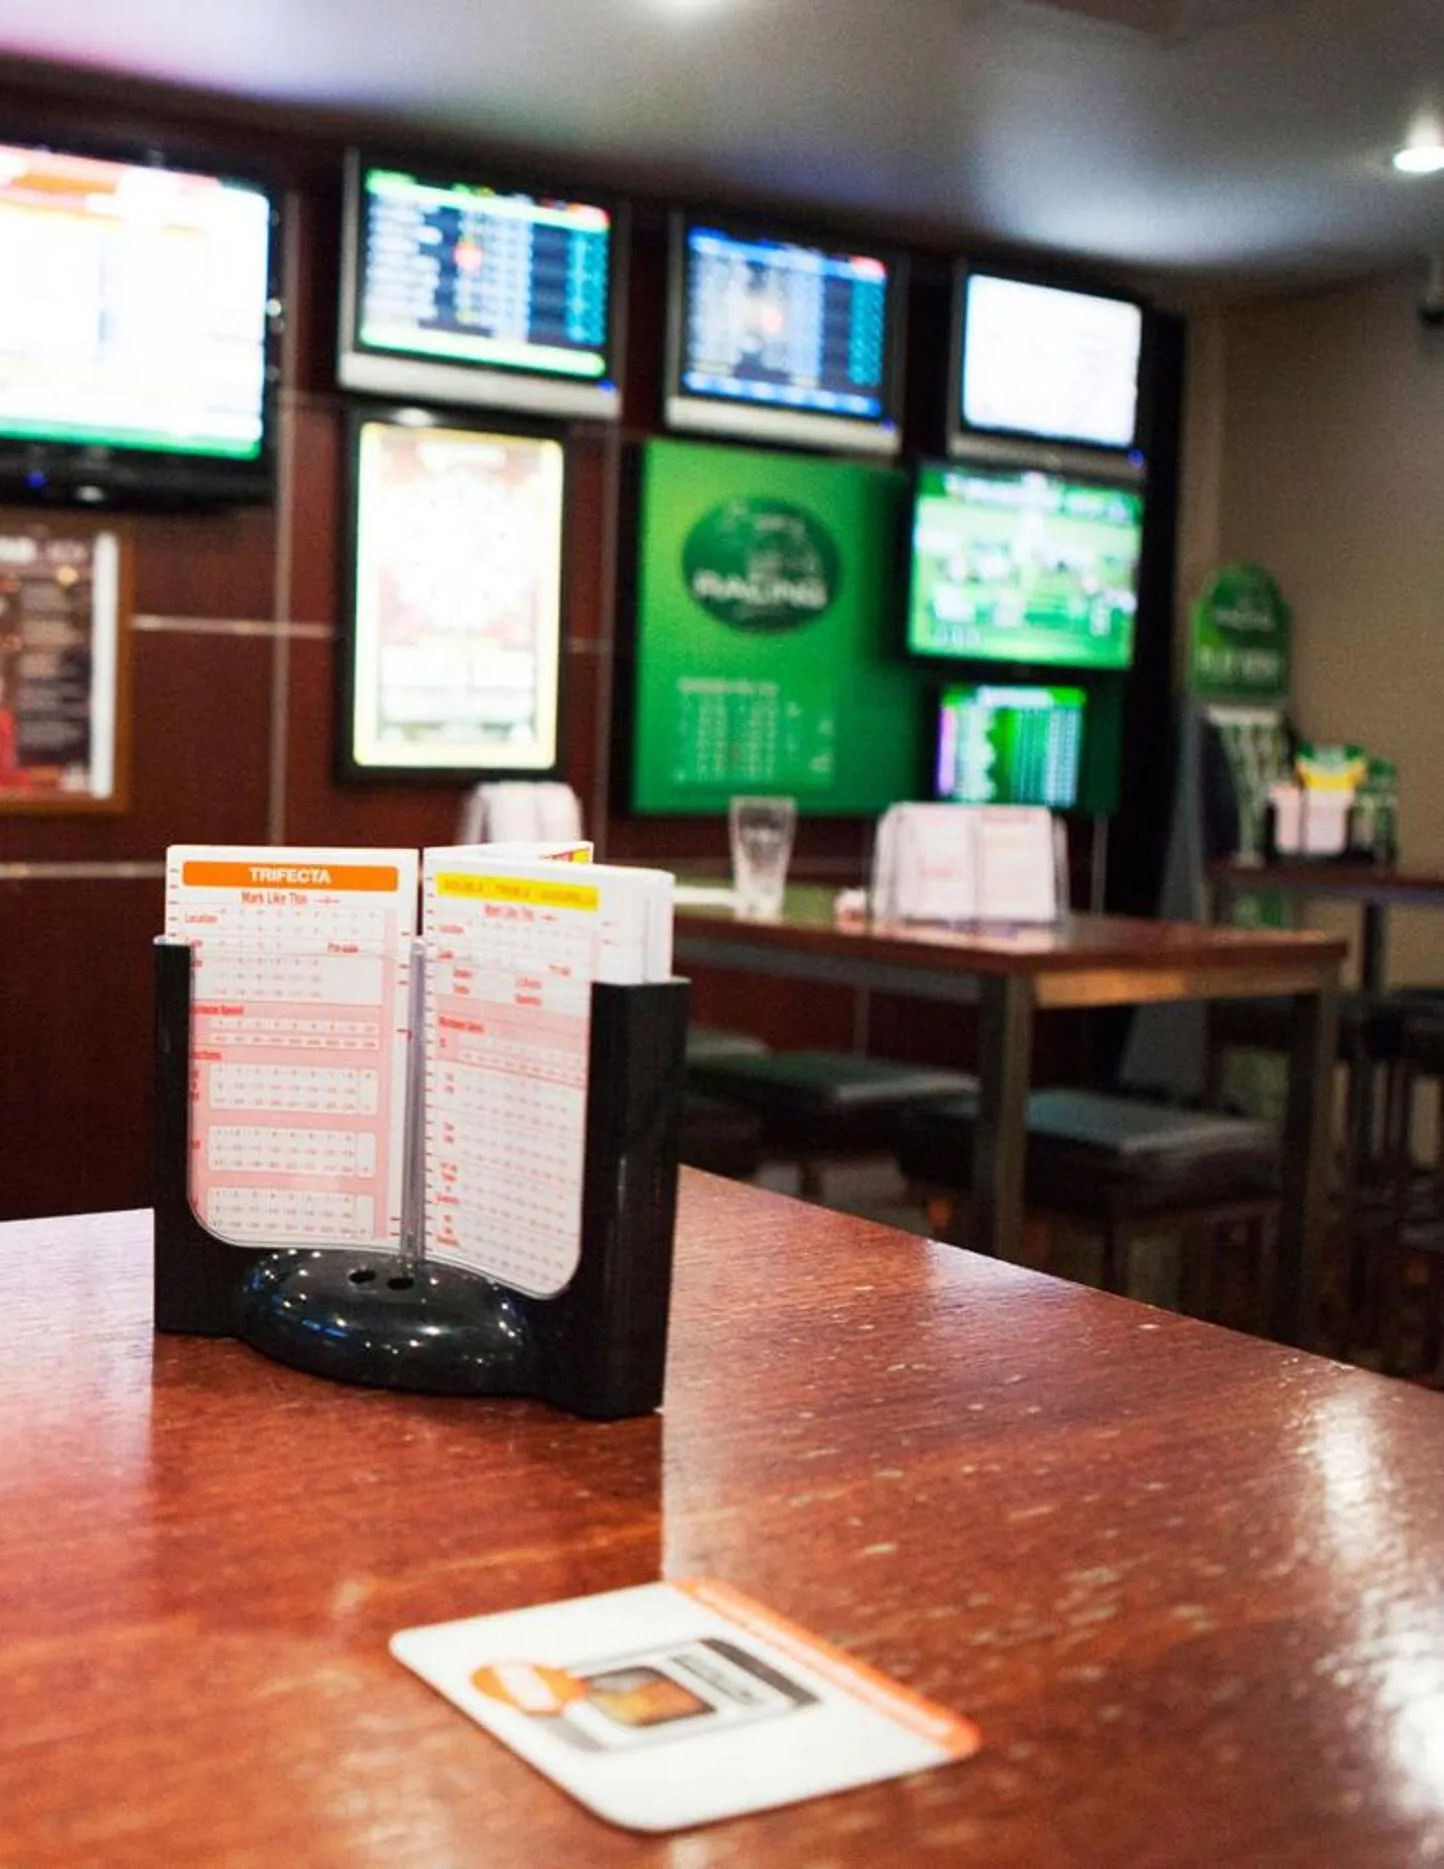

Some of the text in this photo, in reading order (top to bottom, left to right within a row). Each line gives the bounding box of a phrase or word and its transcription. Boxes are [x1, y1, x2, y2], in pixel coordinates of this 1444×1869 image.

[249, 866, 332, 884] TRIFECTA
[241, 891, 262, 904] Mark
[267, 892, 285, 905] Like
[184, 911, 218, 924] Location
